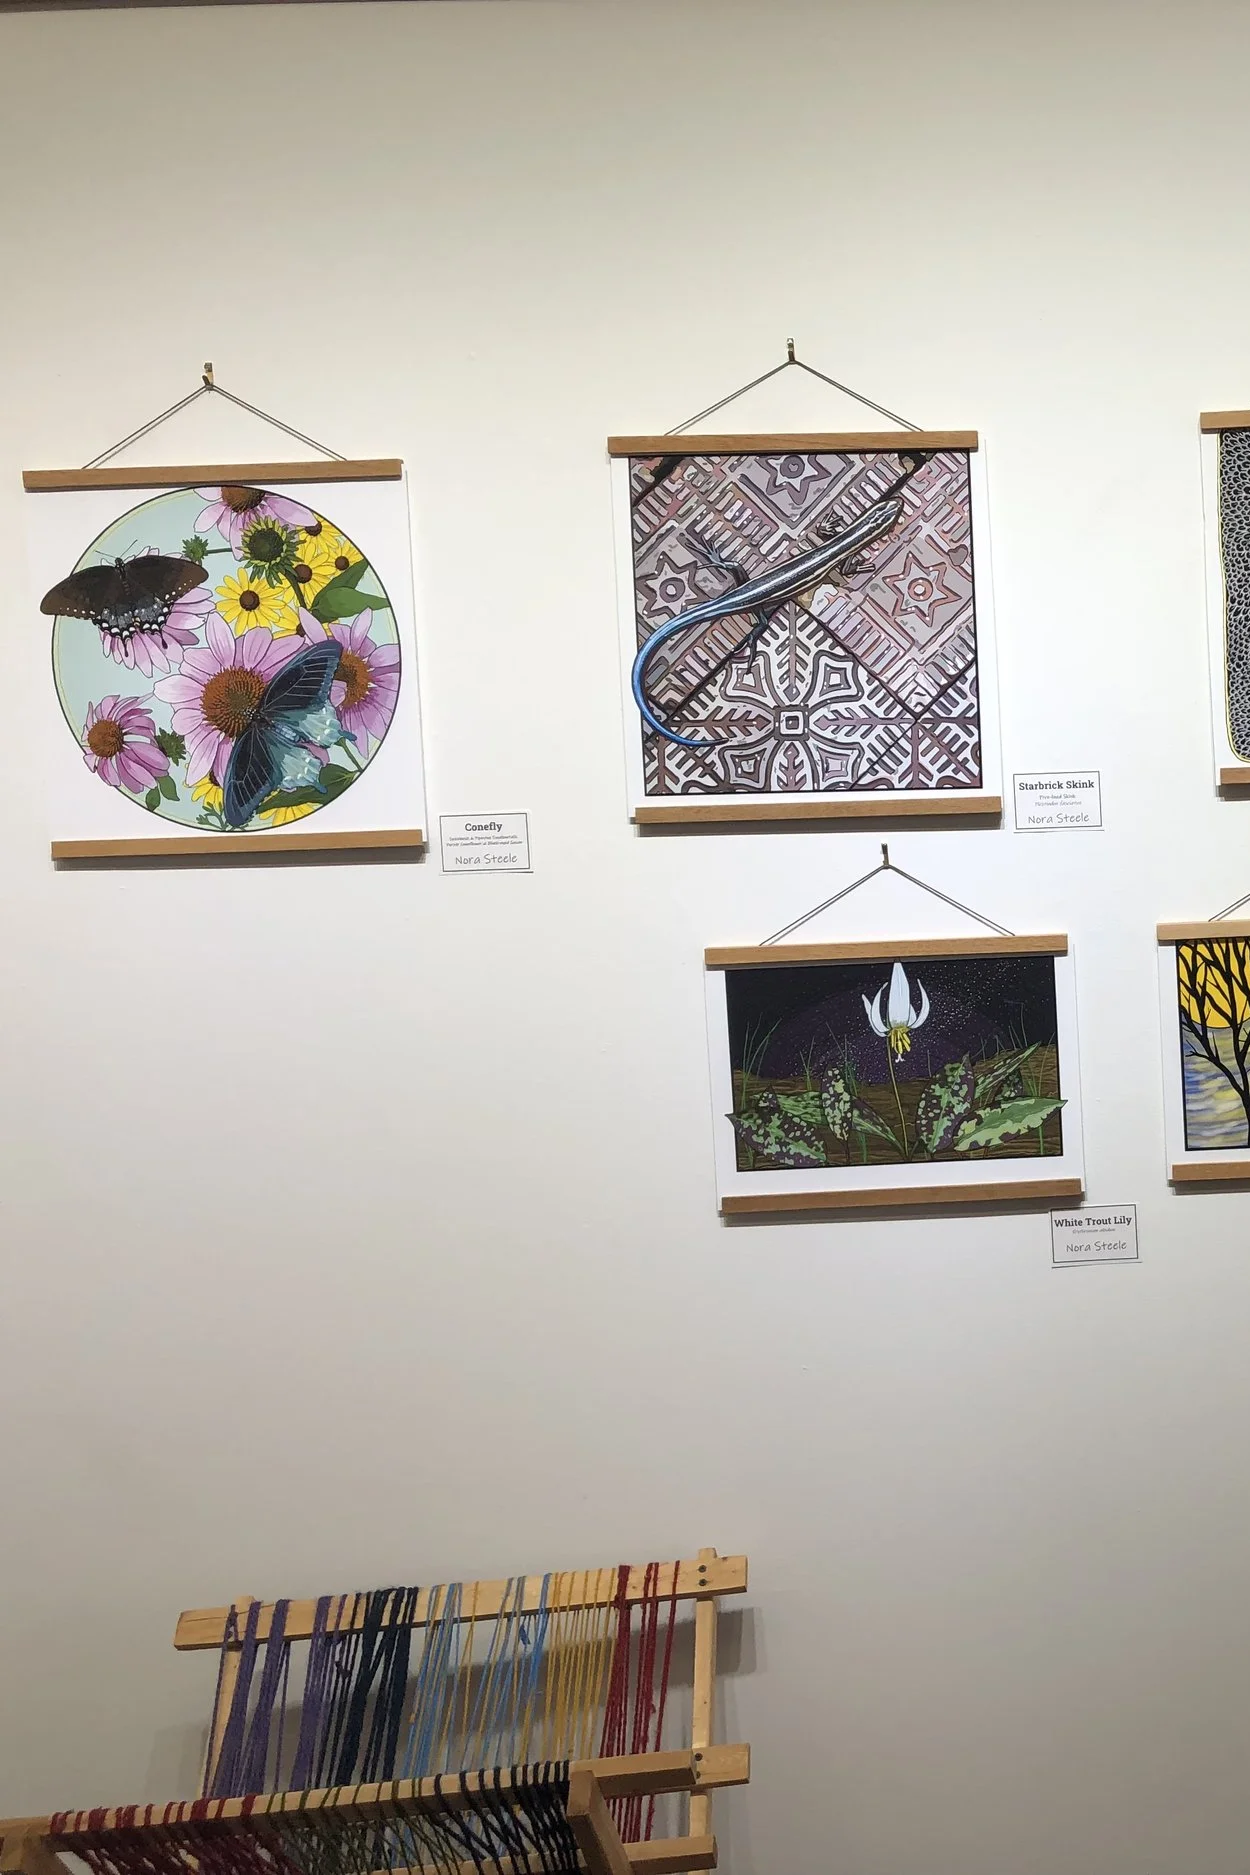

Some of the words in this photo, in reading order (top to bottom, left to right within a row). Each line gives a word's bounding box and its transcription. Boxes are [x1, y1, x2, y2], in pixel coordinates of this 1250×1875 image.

[1018, 781, 1064, 790] Starbrick
[1065, 779, 1095, 789] Skink
[1028, 815, 1054, 824] Nora
[1056, 812, 1090, 823] Steele
[464, 821, 503, 832] Conefly
[455, 855, 481, 864] Nora
[483, 852, 518, 864] Steele
[1053, 1218, 1083, 1228] White
[1085, 1217, 1112, 1226] Trout
[1113, 1215, 1132, 1226] Lily
[1066, 1243, 1091, 1252] Nora
[1094, 1240, 1127, 1252] Steele
